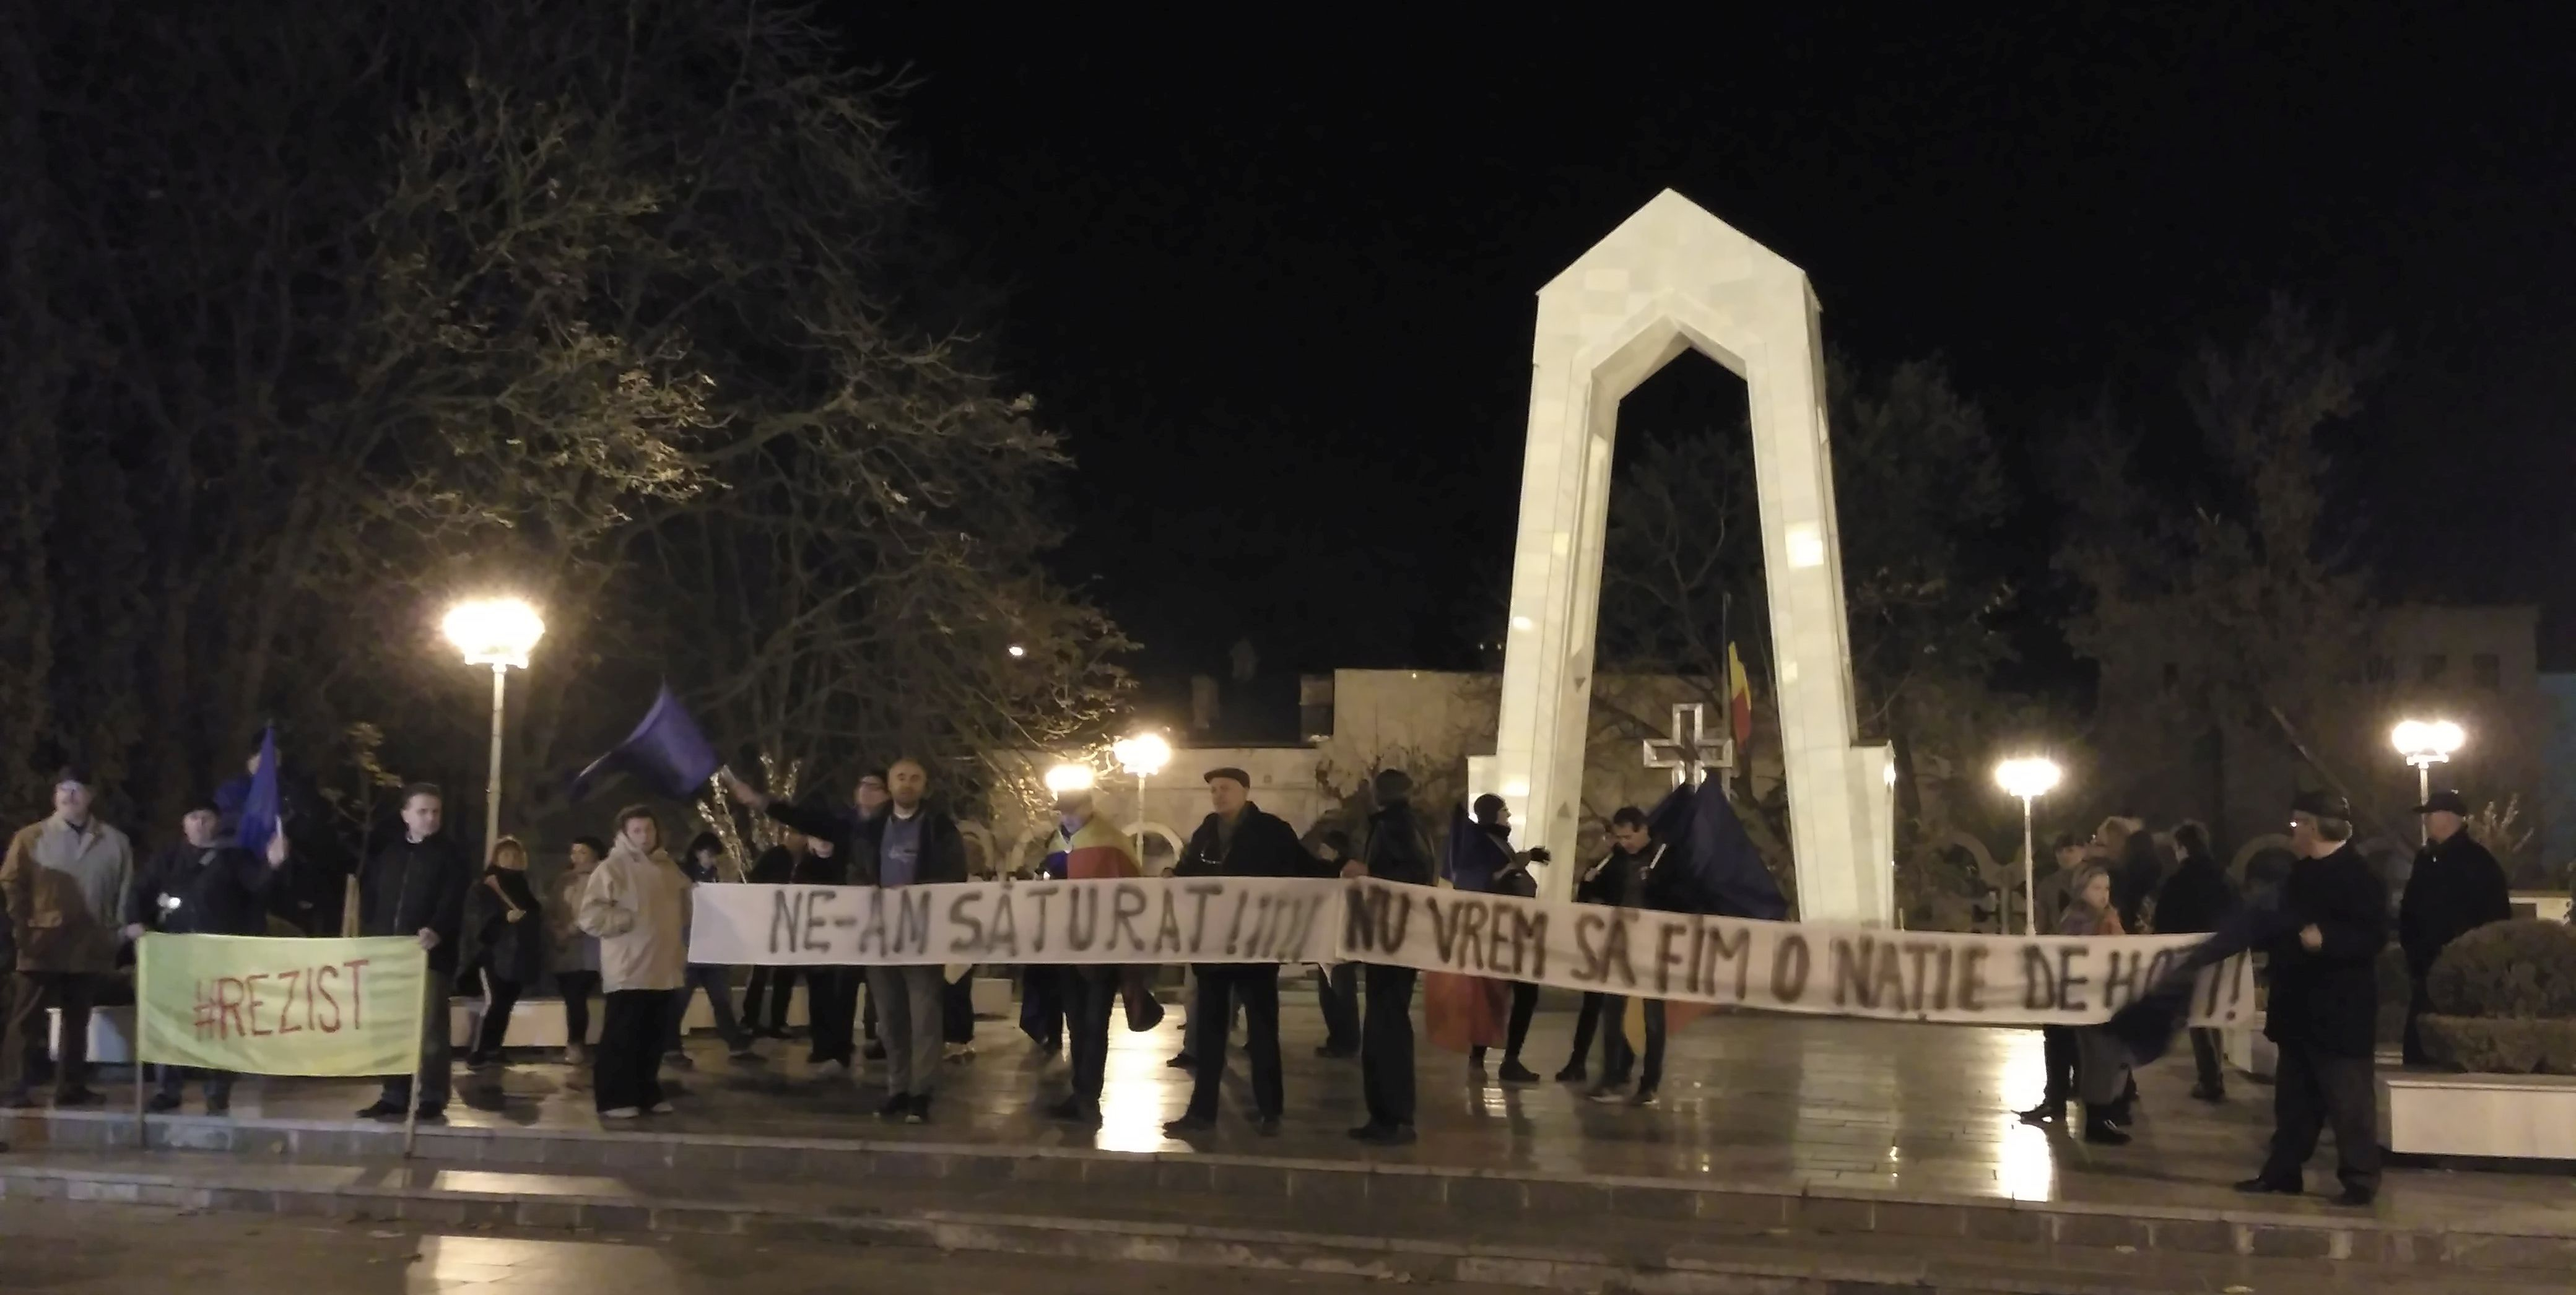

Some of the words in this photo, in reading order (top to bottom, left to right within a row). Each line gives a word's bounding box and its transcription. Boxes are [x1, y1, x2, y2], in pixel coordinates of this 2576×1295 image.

[769, 886, 931, 957] NE-AM
[1344, 885, 1410, 955] NU
[1427, 897, 1548, 979] VREM
[1656, 914, 1751, 1000] FIM
[1770, 933, 1810, 1003] O
[2022, 944, 2089, 1011] DE
[193, 959, 369, 1042] #REZIST
